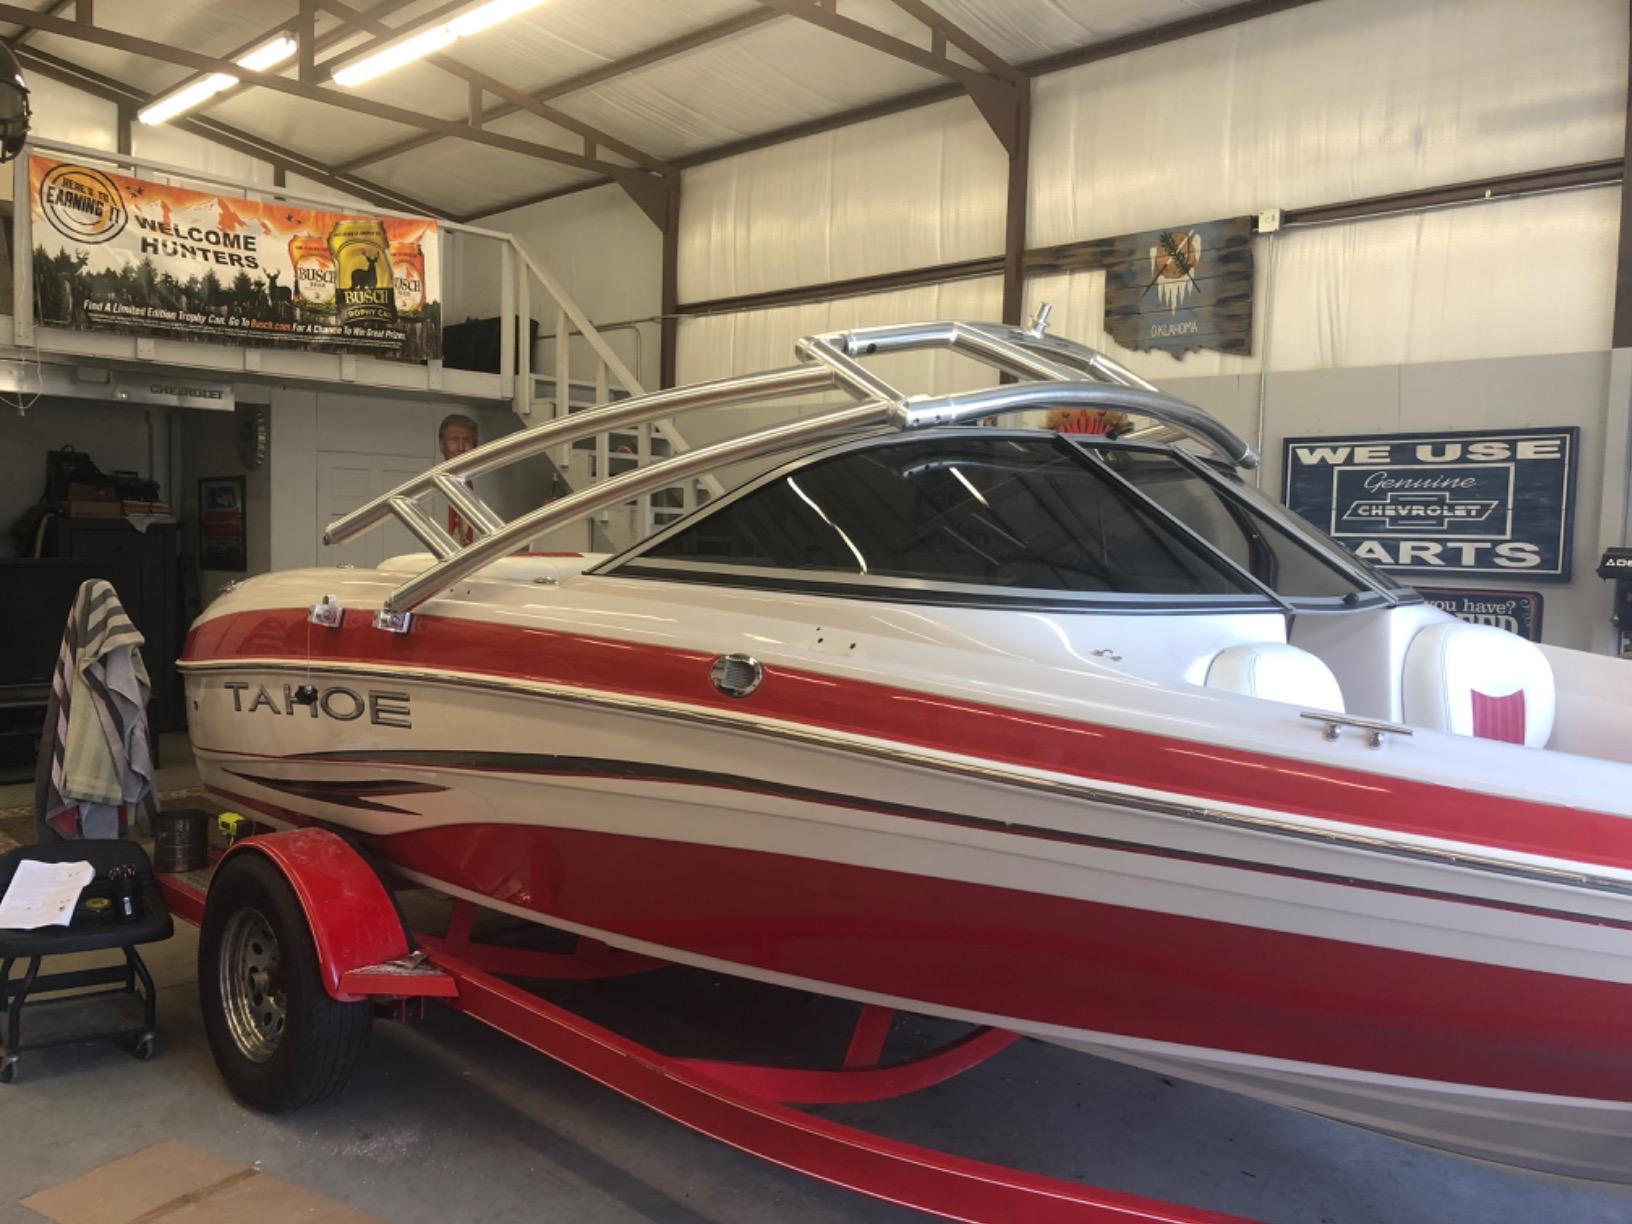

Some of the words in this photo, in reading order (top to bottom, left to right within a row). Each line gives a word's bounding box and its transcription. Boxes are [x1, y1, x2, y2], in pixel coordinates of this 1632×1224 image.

[46, 185, 105, 218] EARNING
[109, 206, 121, 225] IT
[134, 214, 257, 252] WELCOME
[140, 236, 259, 269] HUNTERS
[299, 266, 337, 285] BUSCH
[394, 276, 421, 292] USCH
[344, 288, 388, 304] BUSCH
[83, 299, 103, 312] Find
[104, 302, 112, 313] A
[113, 302, 146, 317] Limited
[147, 307, 177, 320] Edition
[178, 310, 207, 325] Trophy
[228, 315, 240, 327] Go
[241, 316, 250, 328] To
[250, 318, 291, 332] Busch.com
[291, 322, 304, 333] For
[305, 324, 312, 333] A
[313, 325, 343, 336] Chance
[343, 325, 353, 337] To
[353, 327, 366, 336] Win
[366, 328, 385, 339] Great
[1151, 321, 1199, 338] OKLAHOMA
[150, 383, 224, 400] CHEVROLET
[1295, 445, 1392, 465] WE
[1415, 440, 1562, 463] USE
[1363, 470, 1477, 493] Genuine
[1356, 504, 1482, 517] CHEVROLET
[1336, 540, 1542, 568] ARTS
[1462, 598, 1517, 615] have?
[223, 681, 412, 730] TAHOE
